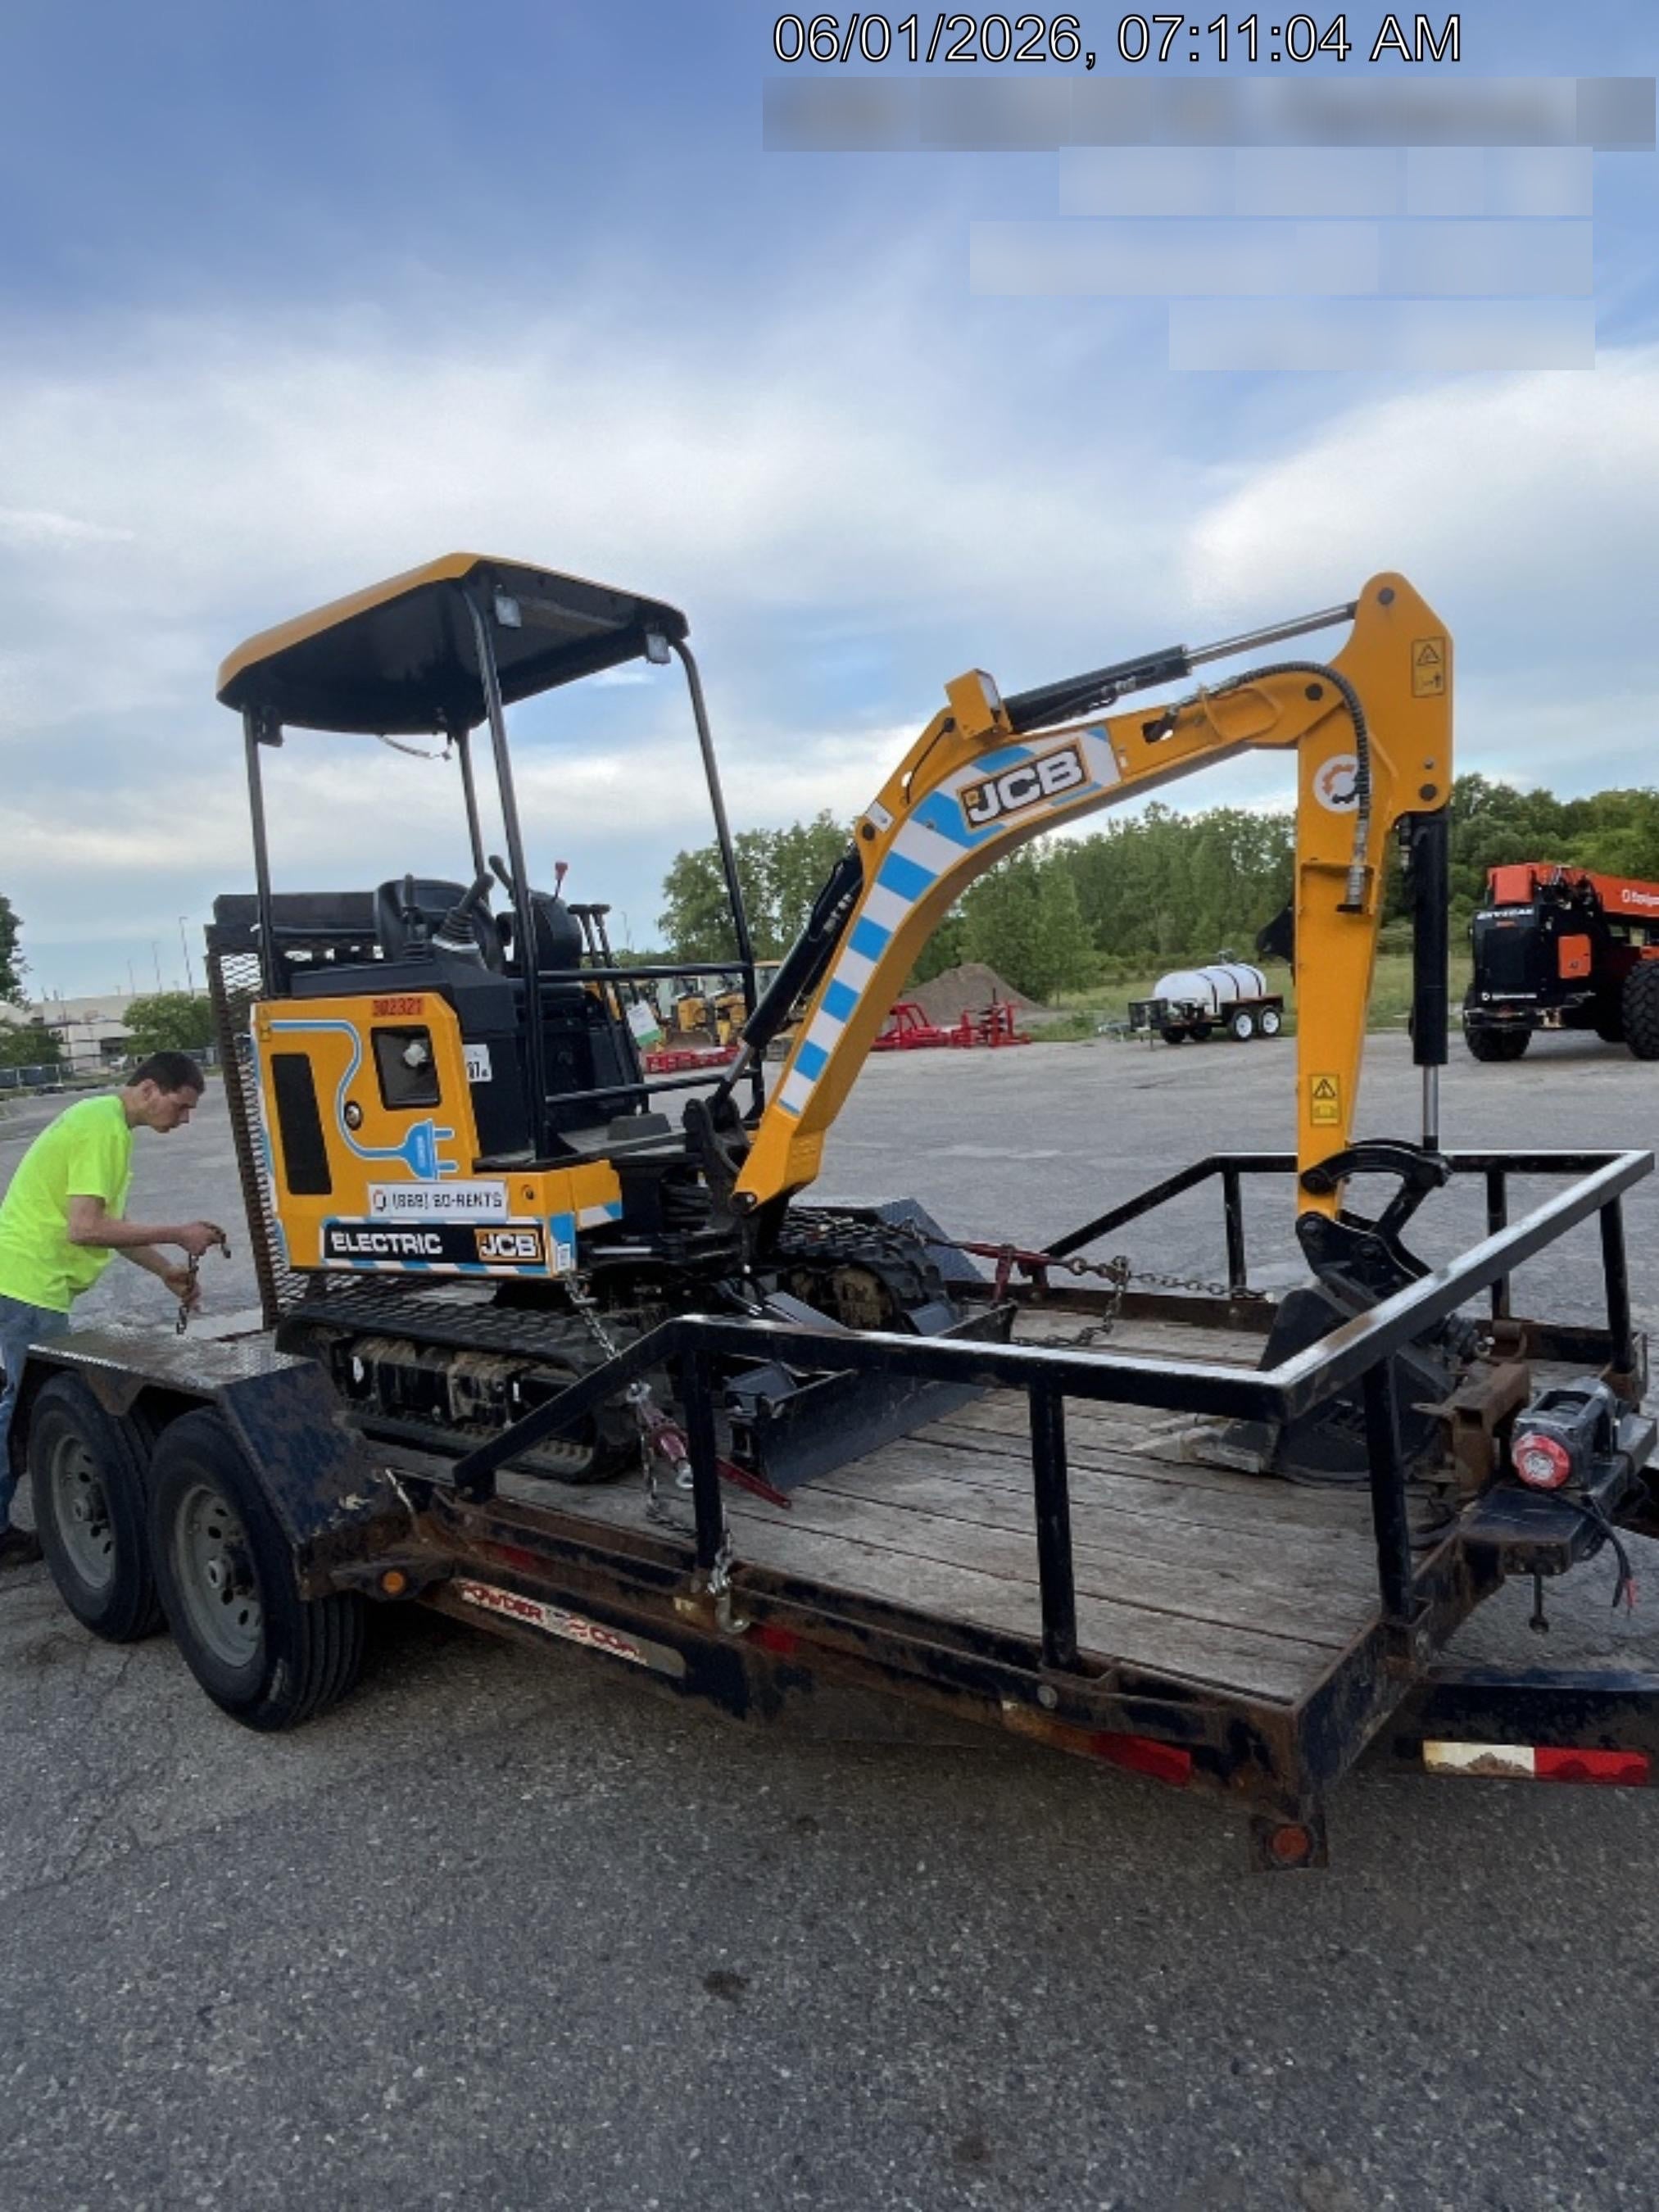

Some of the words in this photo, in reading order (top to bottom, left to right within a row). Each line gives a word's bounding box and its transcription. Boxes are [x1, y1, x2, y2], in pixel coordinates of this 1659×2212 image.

[968, 749, 1085, 823] JCB
[330, 1231, 443, 1255] ELECTRIC
[480, 1233, 537, 1257] JCB
